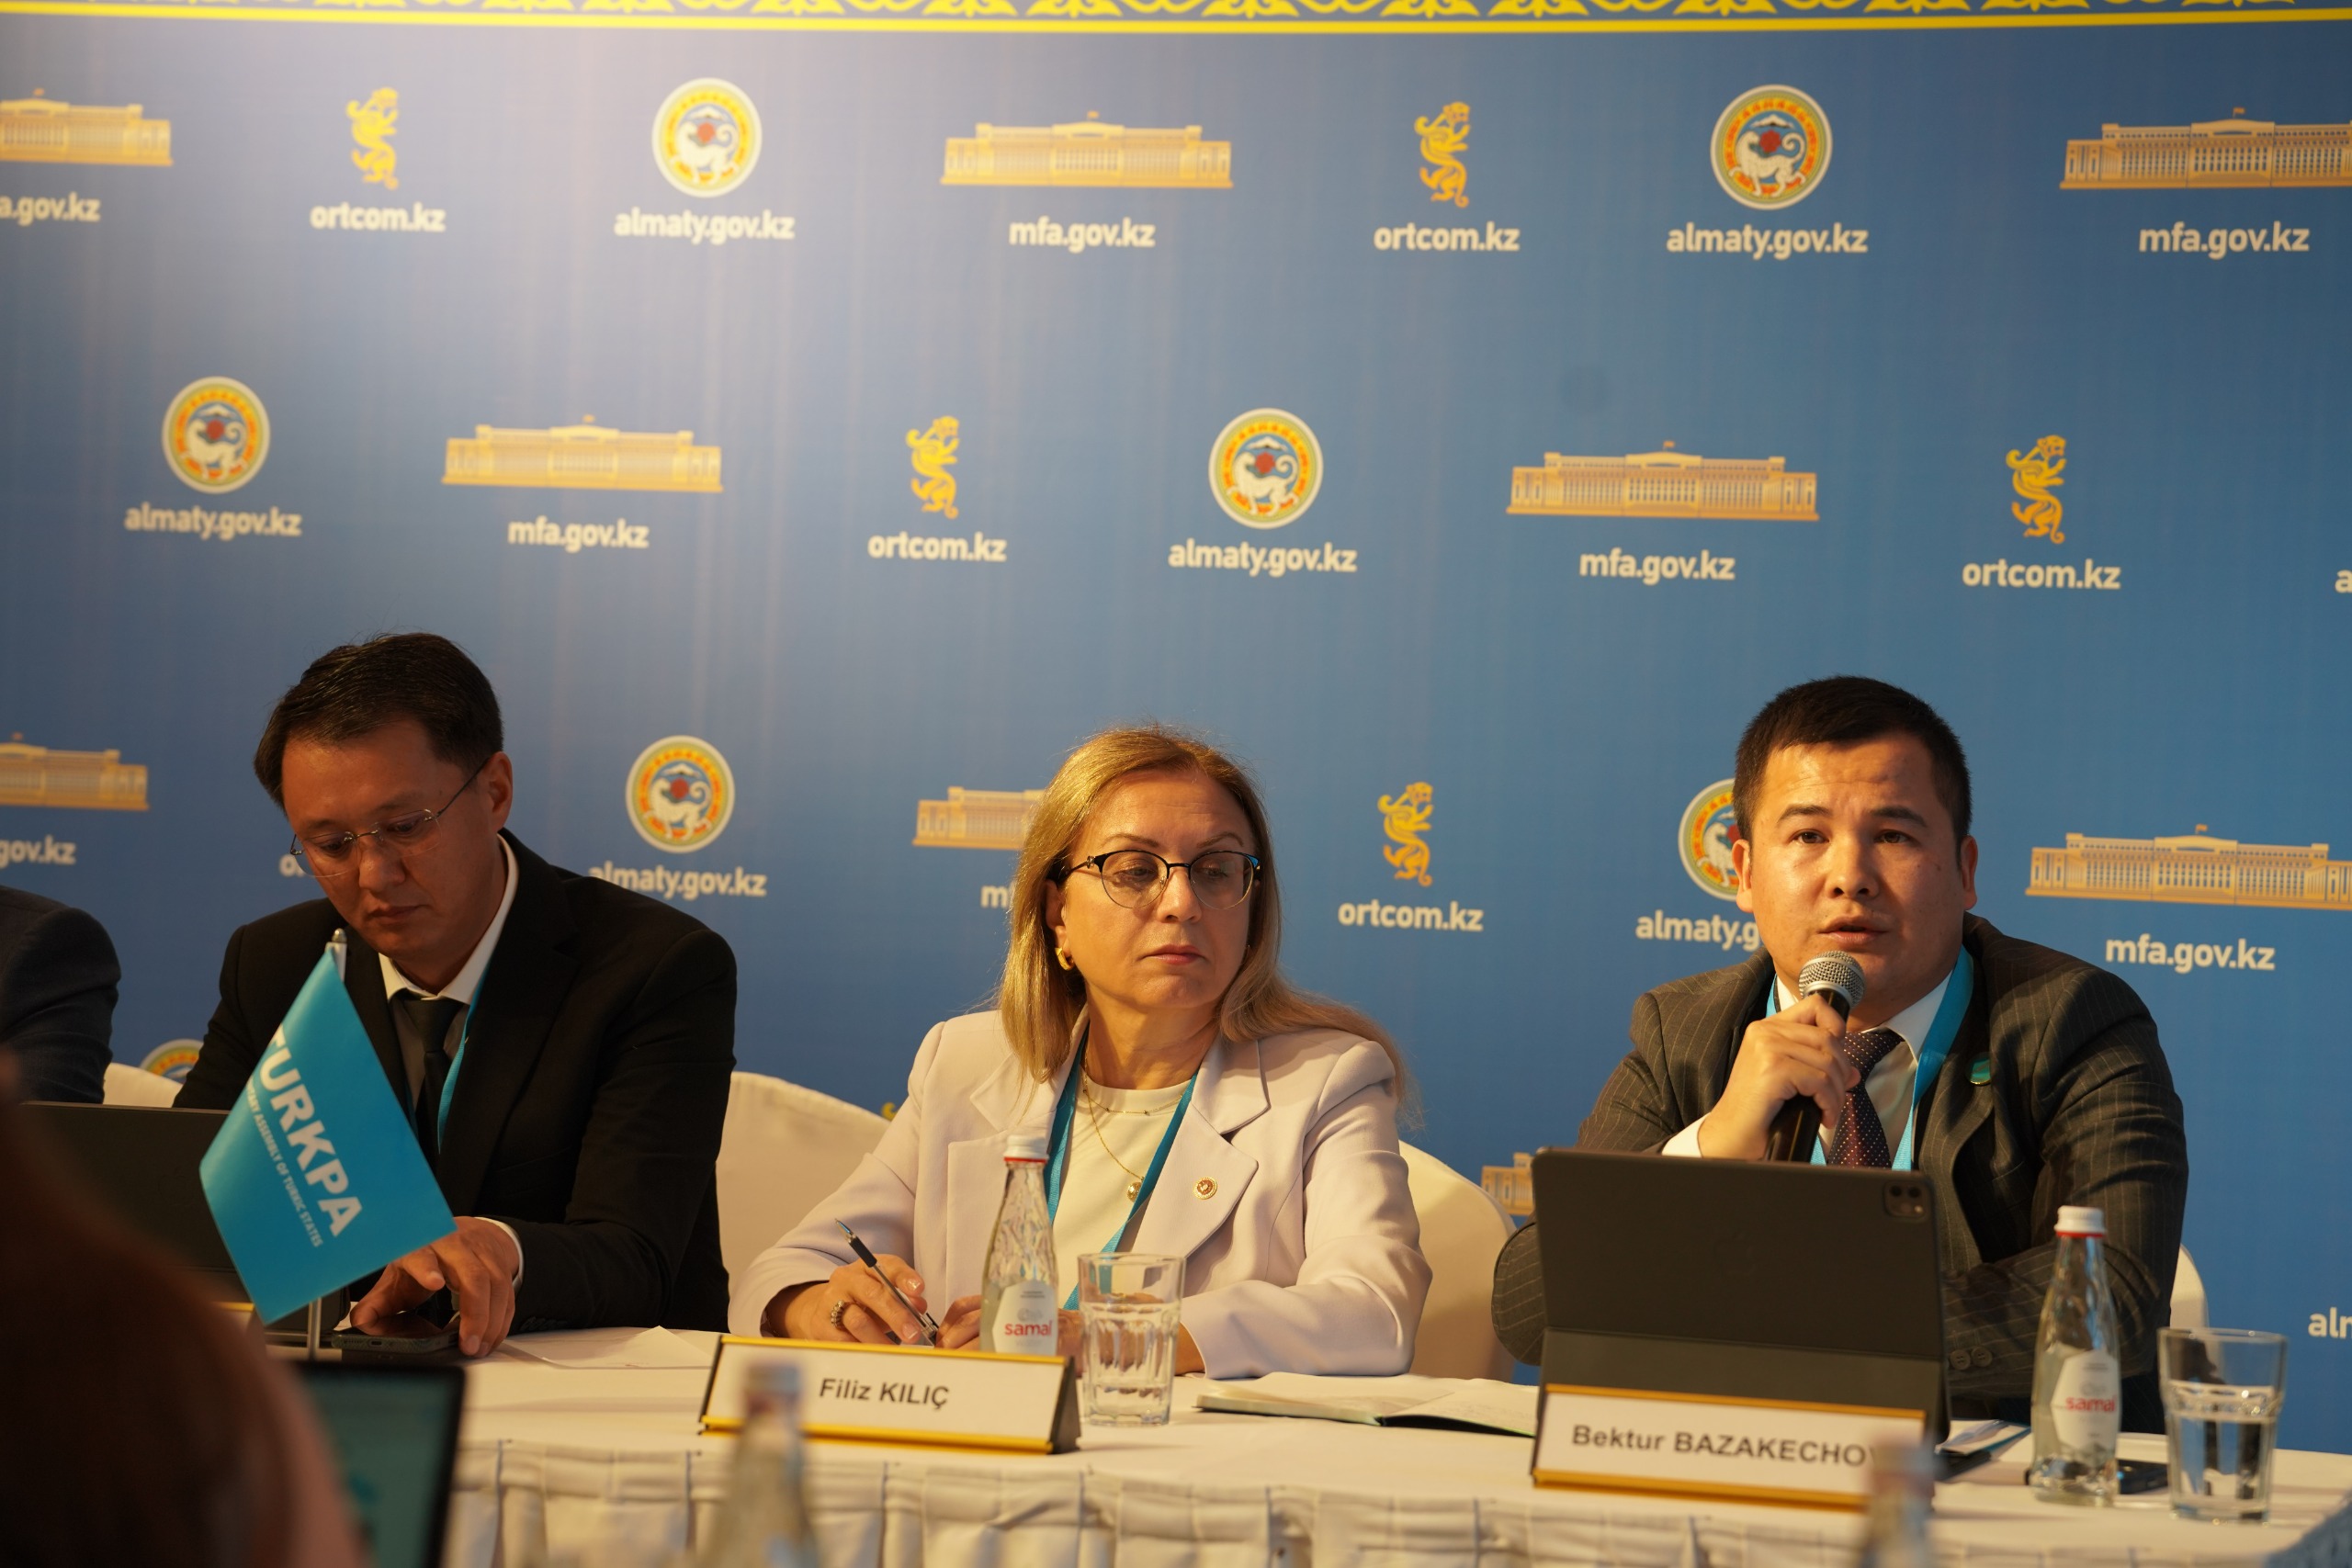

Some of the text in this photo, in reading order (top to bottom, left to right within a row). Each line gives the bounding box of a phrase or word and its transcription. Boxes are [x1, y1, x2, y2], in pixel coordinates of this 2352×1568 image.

[311, 202, 446, 232] ortcom.kz
[614, 207, 795, 245] almaty.gov.kz
[1009, 216, 1155, 254] mfa.gov.kz
[1374, 221, 1520, 251] ortcom.kz
[1667, 222, 1868, 260] almaty.gov.kz
[2139, 221, 2309, 260] mfa.gov.kz
[125, 502, 301, 540] almaty.gov.kz
[508, 516, 650, 553] mfa.gov.kz
[868, 532, 1007, 561] ortcom.kz
[1168, 538, 1357, 577] almaty.gov.kz
[1579, 548, 1735, 585] mfa.gov.kz
[1962, 558, 2120, 589] ortcom.kz
[588, 860, 767, 901] almaty.gov.kz
[1338, 899, 1484, 931] ortcom.kz
[1635, 908, 1760, 952] almaty.g
[2106, 933, 2275, 974] mfa.gov.kz
[1004, 1319, 1053, 1337] samal
[819, 1378, 950, 1410] Filiz KILIÇ
[2065, 1394, 2118, 1414] samal
[1572, 1424, 1665, 1450] Bektur
